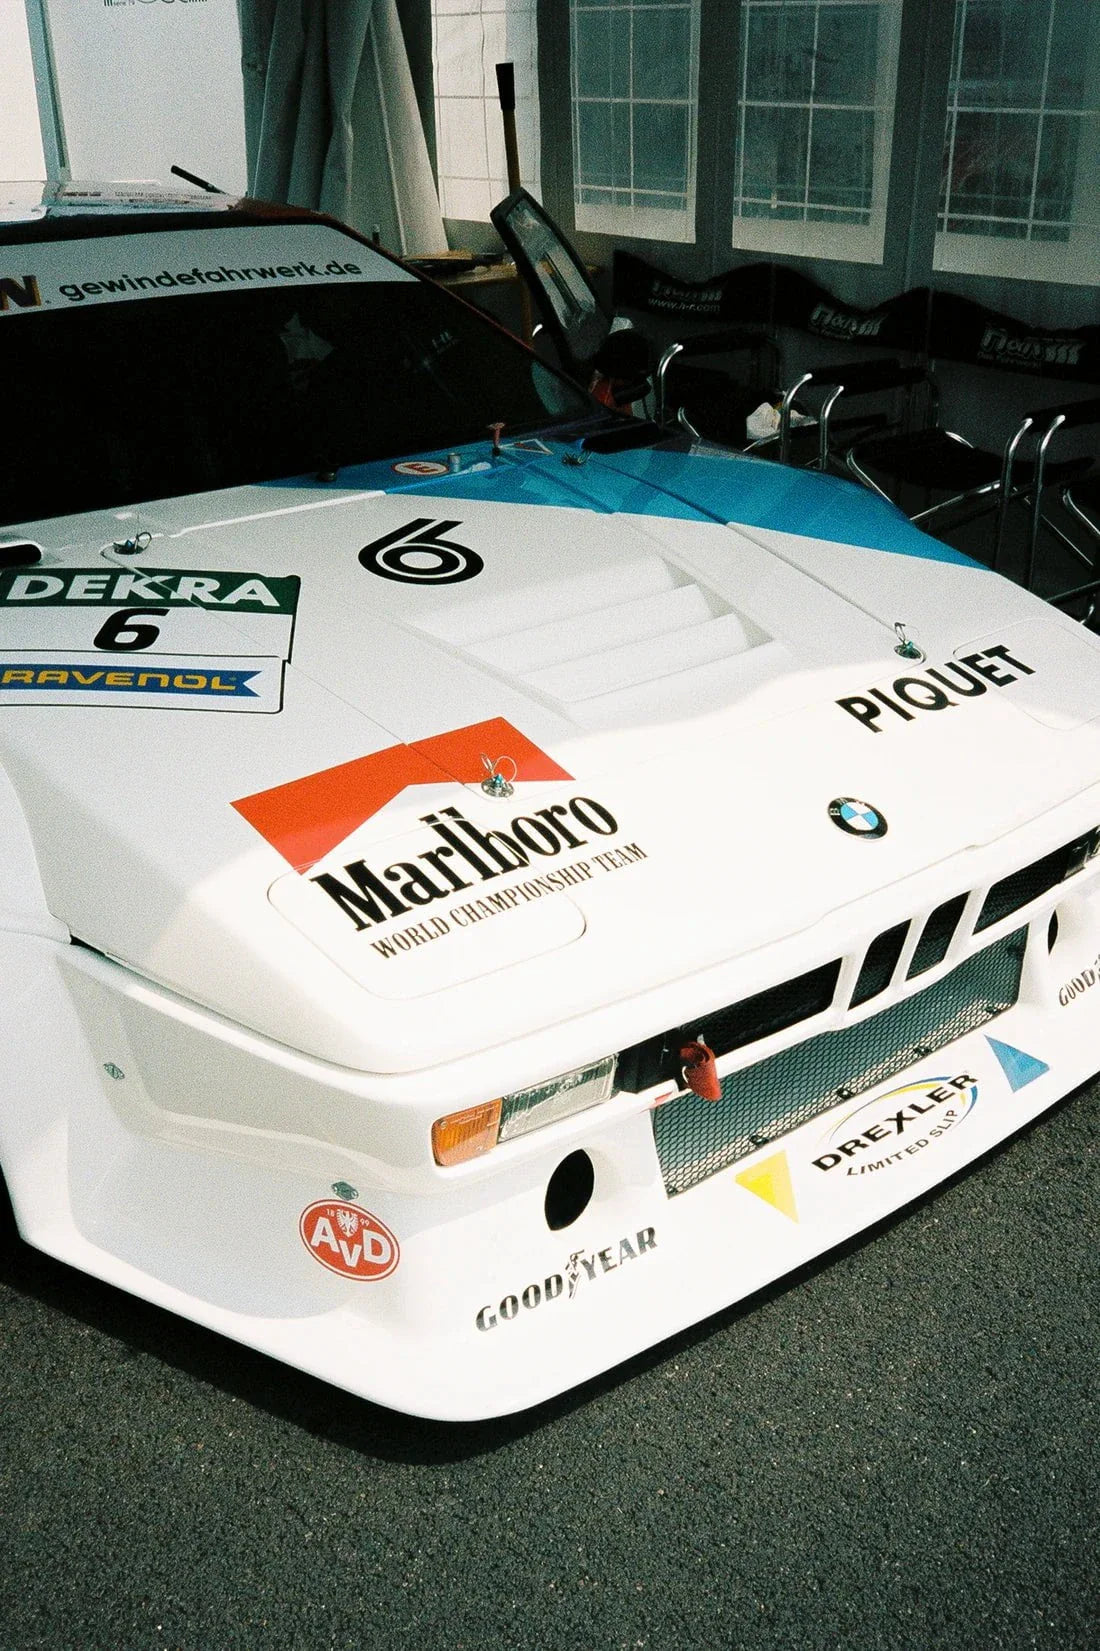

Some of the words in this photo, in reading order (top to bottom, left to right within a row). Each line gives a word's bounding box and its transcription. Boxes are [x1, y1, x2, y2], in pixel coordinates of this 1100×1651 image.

[58, 259, 362, 302] gewindefahrwerk.de
[357, 517, 485, 586] 6
[6, 573, 281, 607] DEKRA
[92, 607, 170, 651] 6
[2, 669, 238, 691] RAVENOL
[834, 644, 1036, 733] PIQUET
[309, 796, 619, 932] Marlboro
[370, 915, 451, 960] WORLD
[449, 861, 593, 928] CHAMPIONSHIP
[591, 842, 649, 873] TEAM
[811, 1074, 979, 1172] DREXLER
[846, 1138, 930, 1176] LIMITED
[929, 1109, 959, 1138] SLIP
